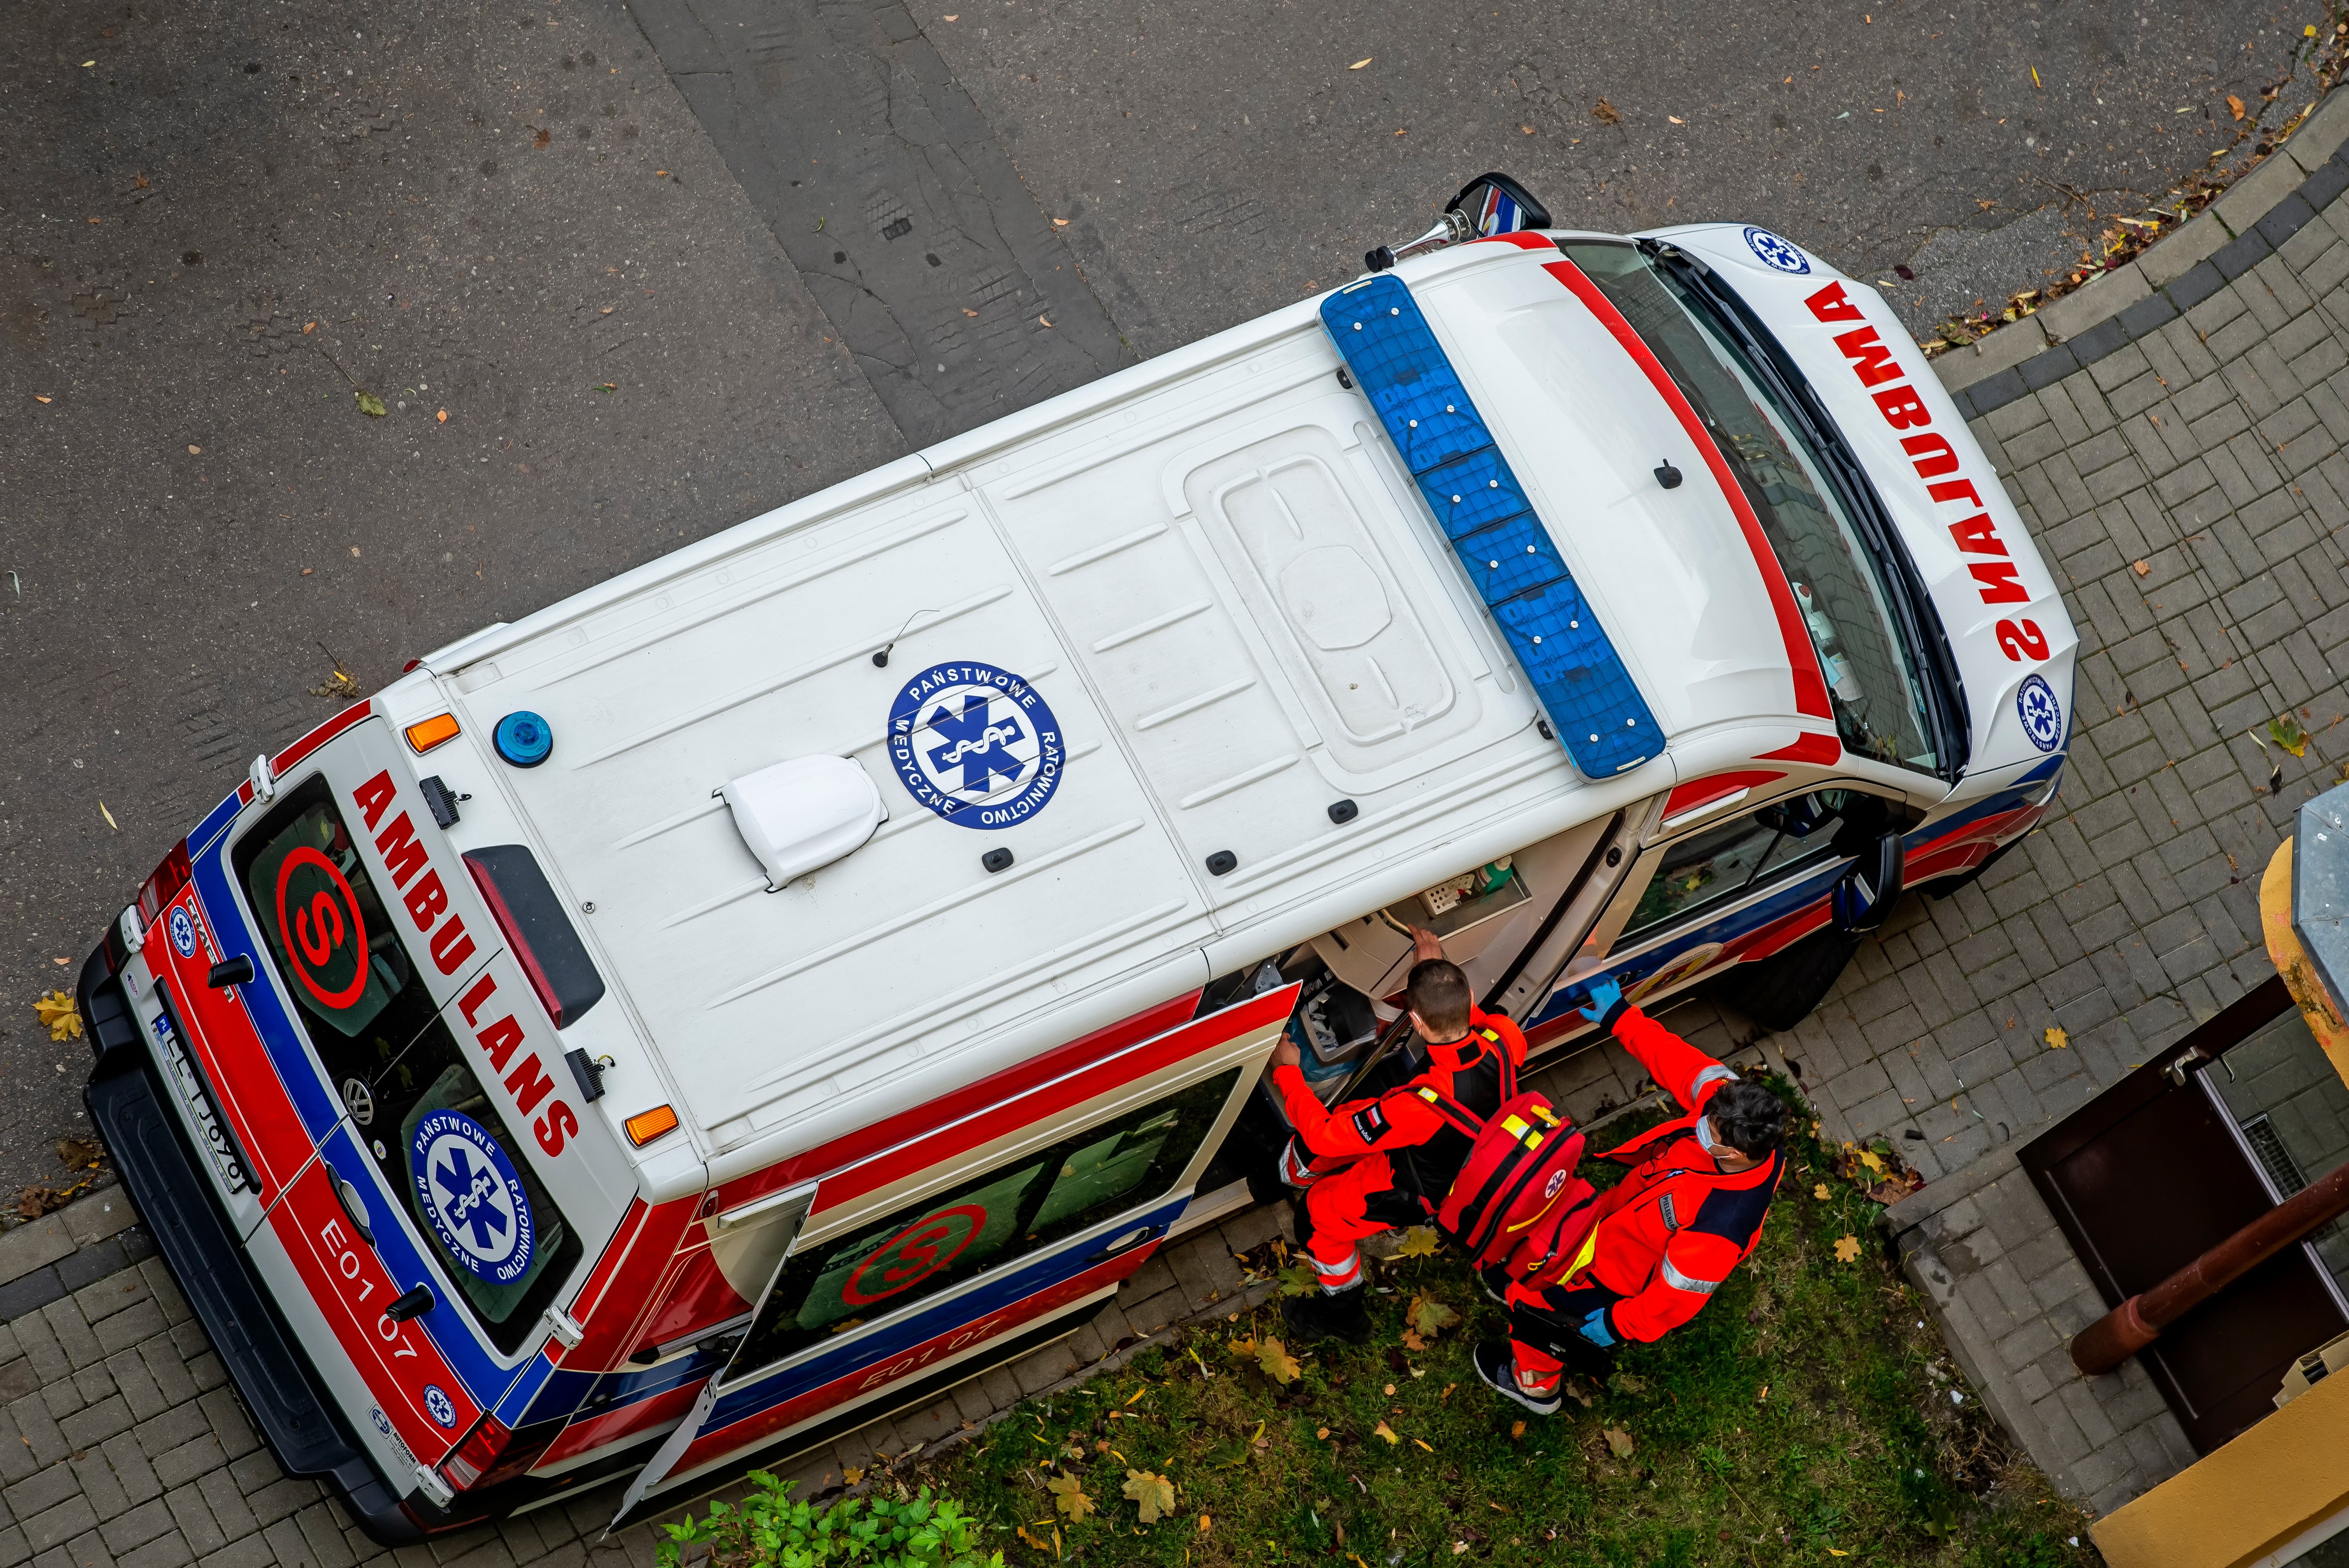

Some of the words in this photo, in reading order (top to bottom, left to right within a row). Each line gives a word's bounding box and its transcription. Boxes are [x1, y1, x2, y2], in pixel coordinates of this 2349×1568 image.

[909, 668, 1036, 709] PAŃSTWOWE
[2019, 677, 2044, 704] RATOWNICTWO
[2050, 693, 2060, 740] MEDYCZNE
[895, 720, 955, 814] MEDYCZNE
[981, 731, 1059, 824] RATOWNICTWO
[296, 891, 344, 967] S
[160, 1018, 167, 1031] PL
[416, 1117, 495, 1156] PAŃSTWOWE
[417, 1176, 479, 1273] MEDYCZNE
[497, 1179, 531, 1280] RATOWNICTWO
[884, 1226, 950, 1282] S
[374, 1412, 387, 1430] AUTOFORM
[391, 1447, 405, 1466] POLAND
[393, 1432, 416, 1464] AUTOFORM
